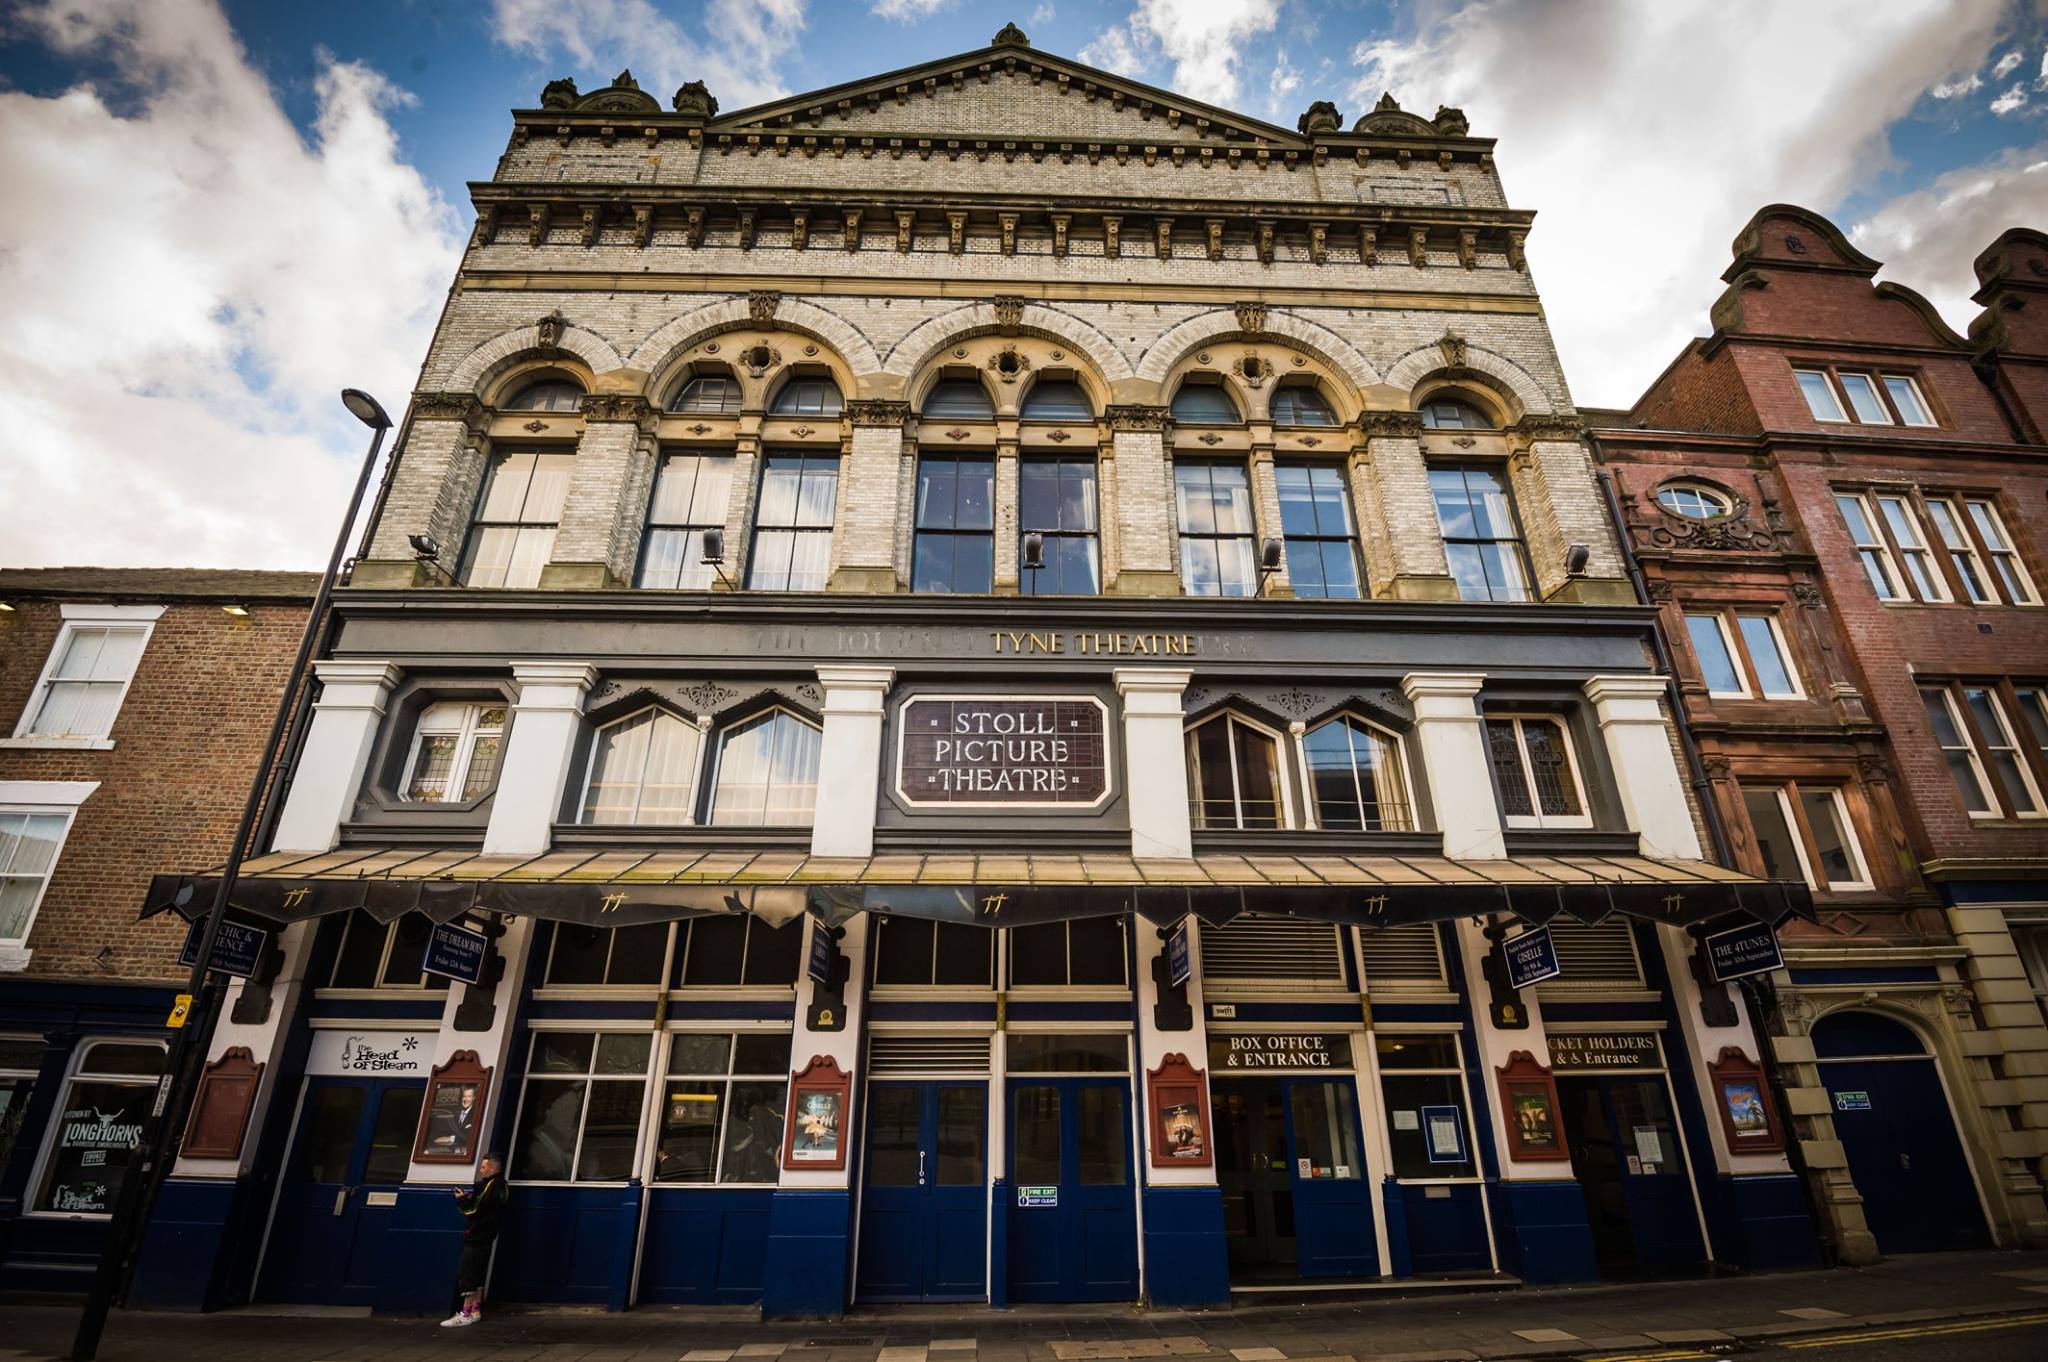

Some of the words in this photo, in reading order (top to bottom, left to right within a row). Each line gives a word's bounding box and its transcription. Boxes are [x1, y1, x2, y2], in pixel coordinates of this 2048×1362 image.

[990, 632, 1064, 655] TYNE
[1076, 633, 1196, 656] THEATRE
[955, 713, 1055, 734] STOLL
[935, 740, 1068, 762] PICTURE
[937, 769, 1067, 791] THEATRE
[436, 928, 450, 943] THE
[449, 933, 469, 950] DREAM
[468, 940, 483, 954] BOYS
[1714, 943, 1734, 958] THE
[1735, 935, 1771, 953] 4TUNES
[1517, 946, 1543, 963] GISELLE
[1230, 1036, 1262, 1050] BOX
[1267, 1036, 1324, 1050] OFFICE
[1547, 1037, 1584, 1050] CKET
[1588, 1036, 1655, 1050] HOLDERS
[355, 1050, 399, 1061] Head
[1227, 1053, 1239, 1066] &
[1244, 1052, 1331, 1066] ENTRANCE
[1556, 1052, 1567, 1065] &
[1584, 1052, 1639, 1065] Entrance
[353, 1061, 371, 1070] of
[371, 1060, 418, 1071] Steam
[61, 1123, 143, 1150] LONGHORNS
